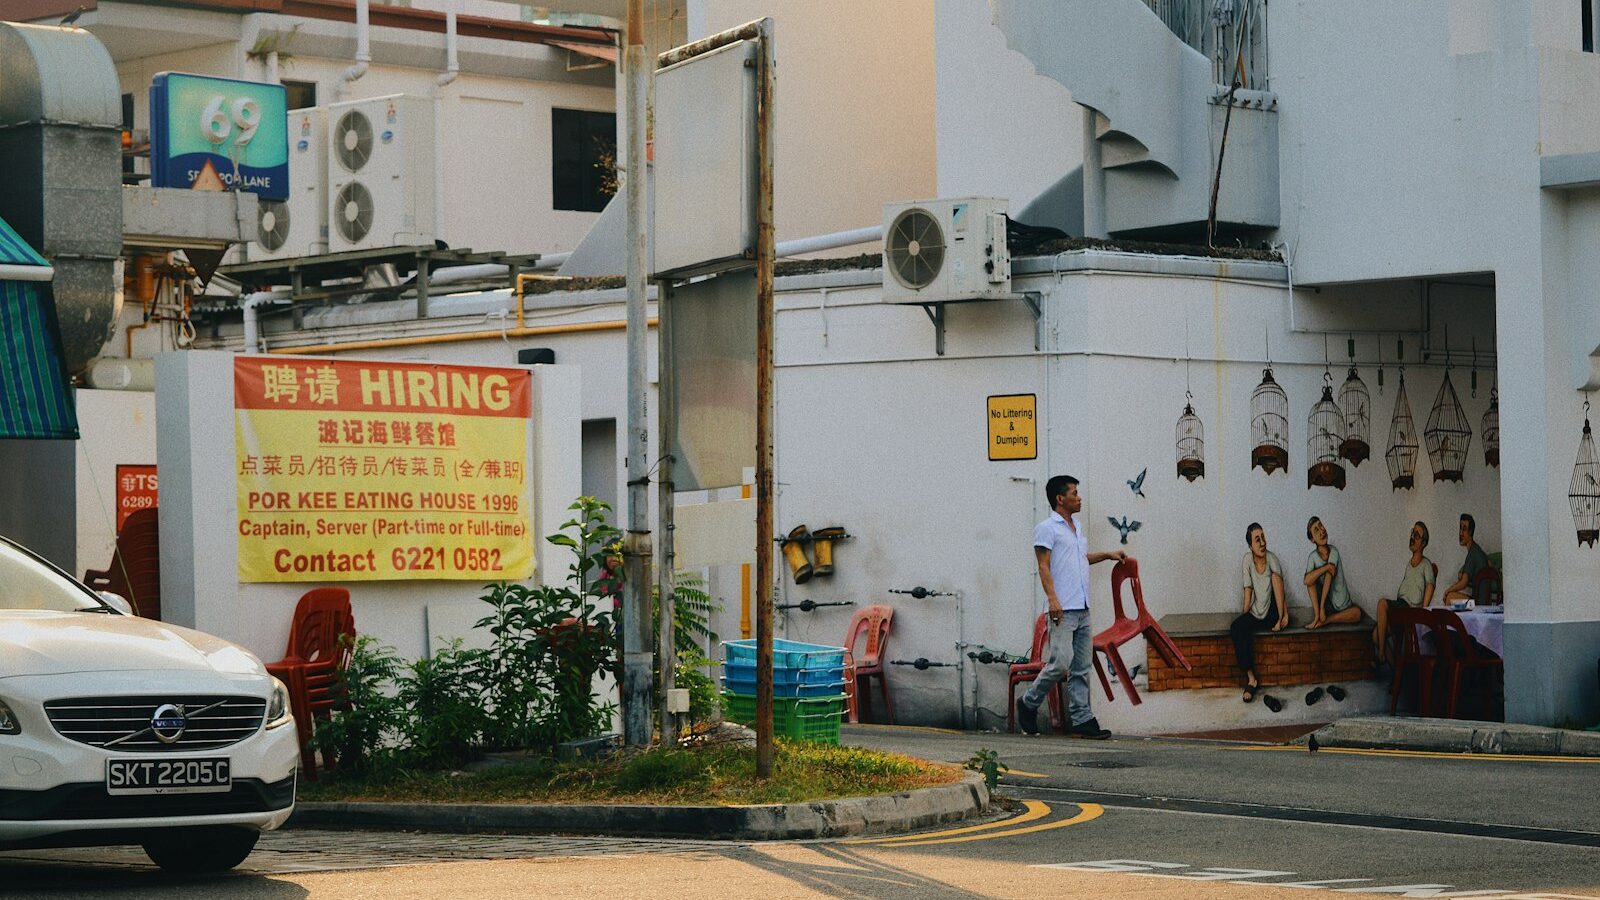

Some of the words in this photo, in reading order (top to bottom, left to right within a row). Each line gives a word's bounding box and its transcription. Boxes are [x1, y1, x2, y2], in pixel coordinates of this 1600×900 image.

[201, 95, 261, 145] 69
[244, 176, 271, 188] LANE
[261, 364, 340, 405] 聘请
[360, 369, 511, 411] HIRING
[991, 409, 1001, 419] No
[1003, 408, 1033, 420] Littering
[1009, 421, 1015, 431] &
[996, 434, 1029, 446] Dumping
[122, 496, 152, 508] 6289
[248, 491, 291, 509] POR
[298, 491, 337, 509] KEE
[344, 491, 413, 509] EATING
[420, 492, 476, 510] HOUSE
[482, 494, 518, 512] 1996
[239, 518, 311, 540] Captain,
[316, 518, 367, 535] Server
[373, 518, 445, 539] (Part-time
[449, 522, 464, 535] or
[467, 519, 526, 540] Full-time)
[274, 548, 376, 573] Contact
[391, 546, 445, 571] 6221
[453, 547, 503, 571] 0582
